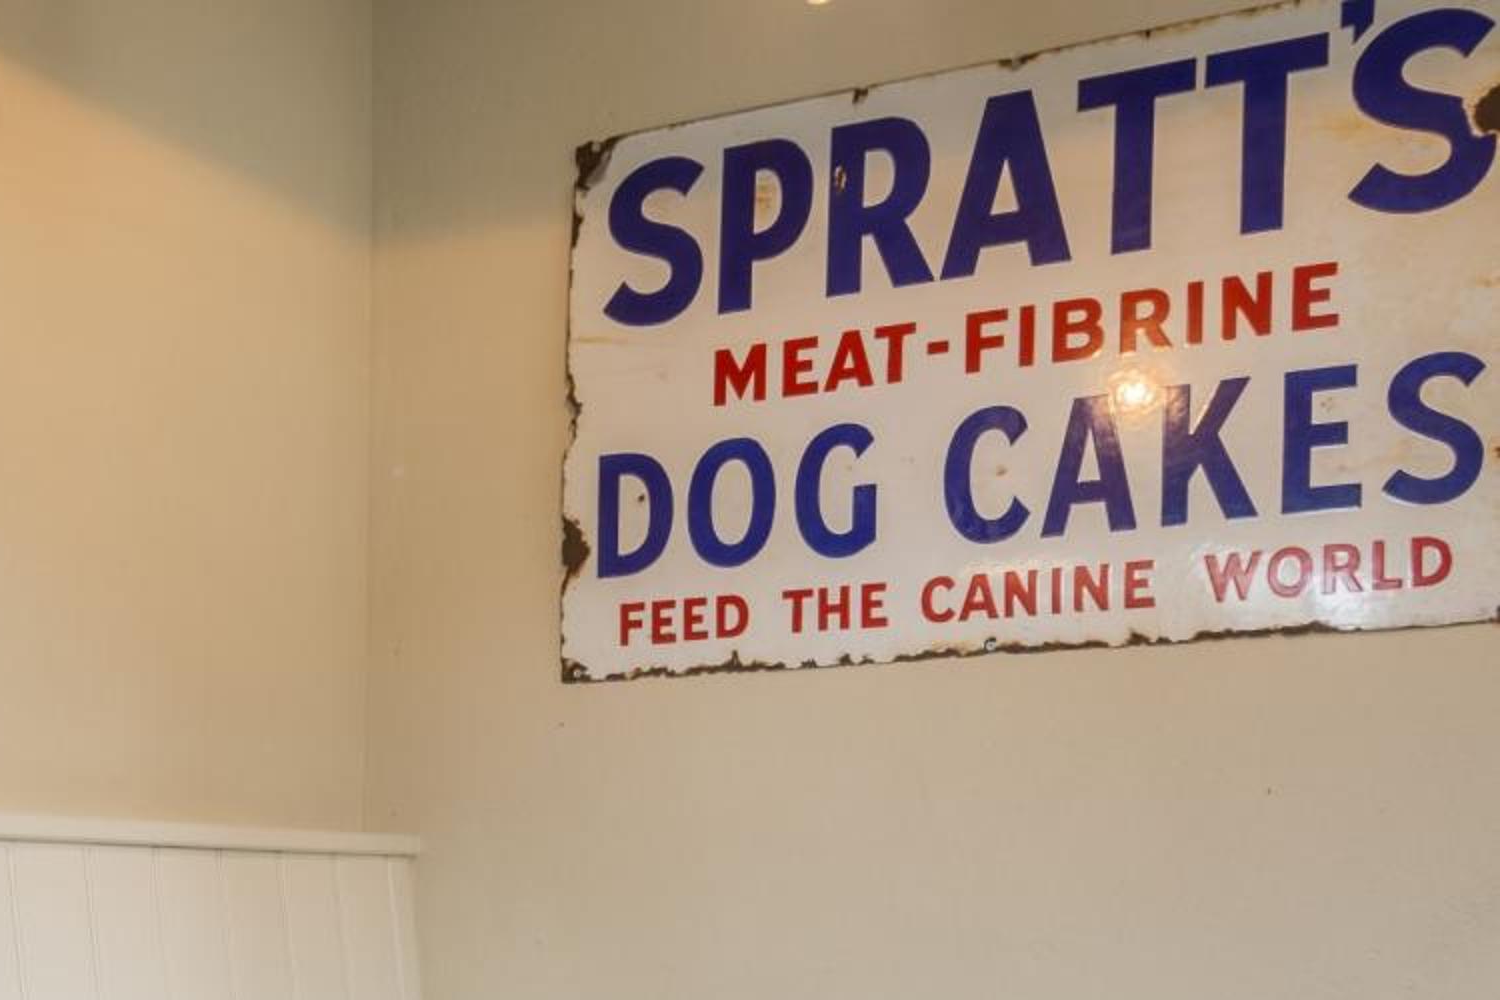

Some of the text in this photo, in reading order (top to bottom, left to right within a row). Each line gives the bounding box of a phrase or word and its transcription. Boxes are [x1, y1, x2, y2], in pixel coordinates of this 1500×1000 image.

[602, 0, 1497, 326] SPRATT'S
[713, 262, 1340, 406] MEAT-FIBRINE
[596, 351, 1487, 579] DOG CAKES
[619, 536, 1454, 647] FEED THE CANINE WORLD
